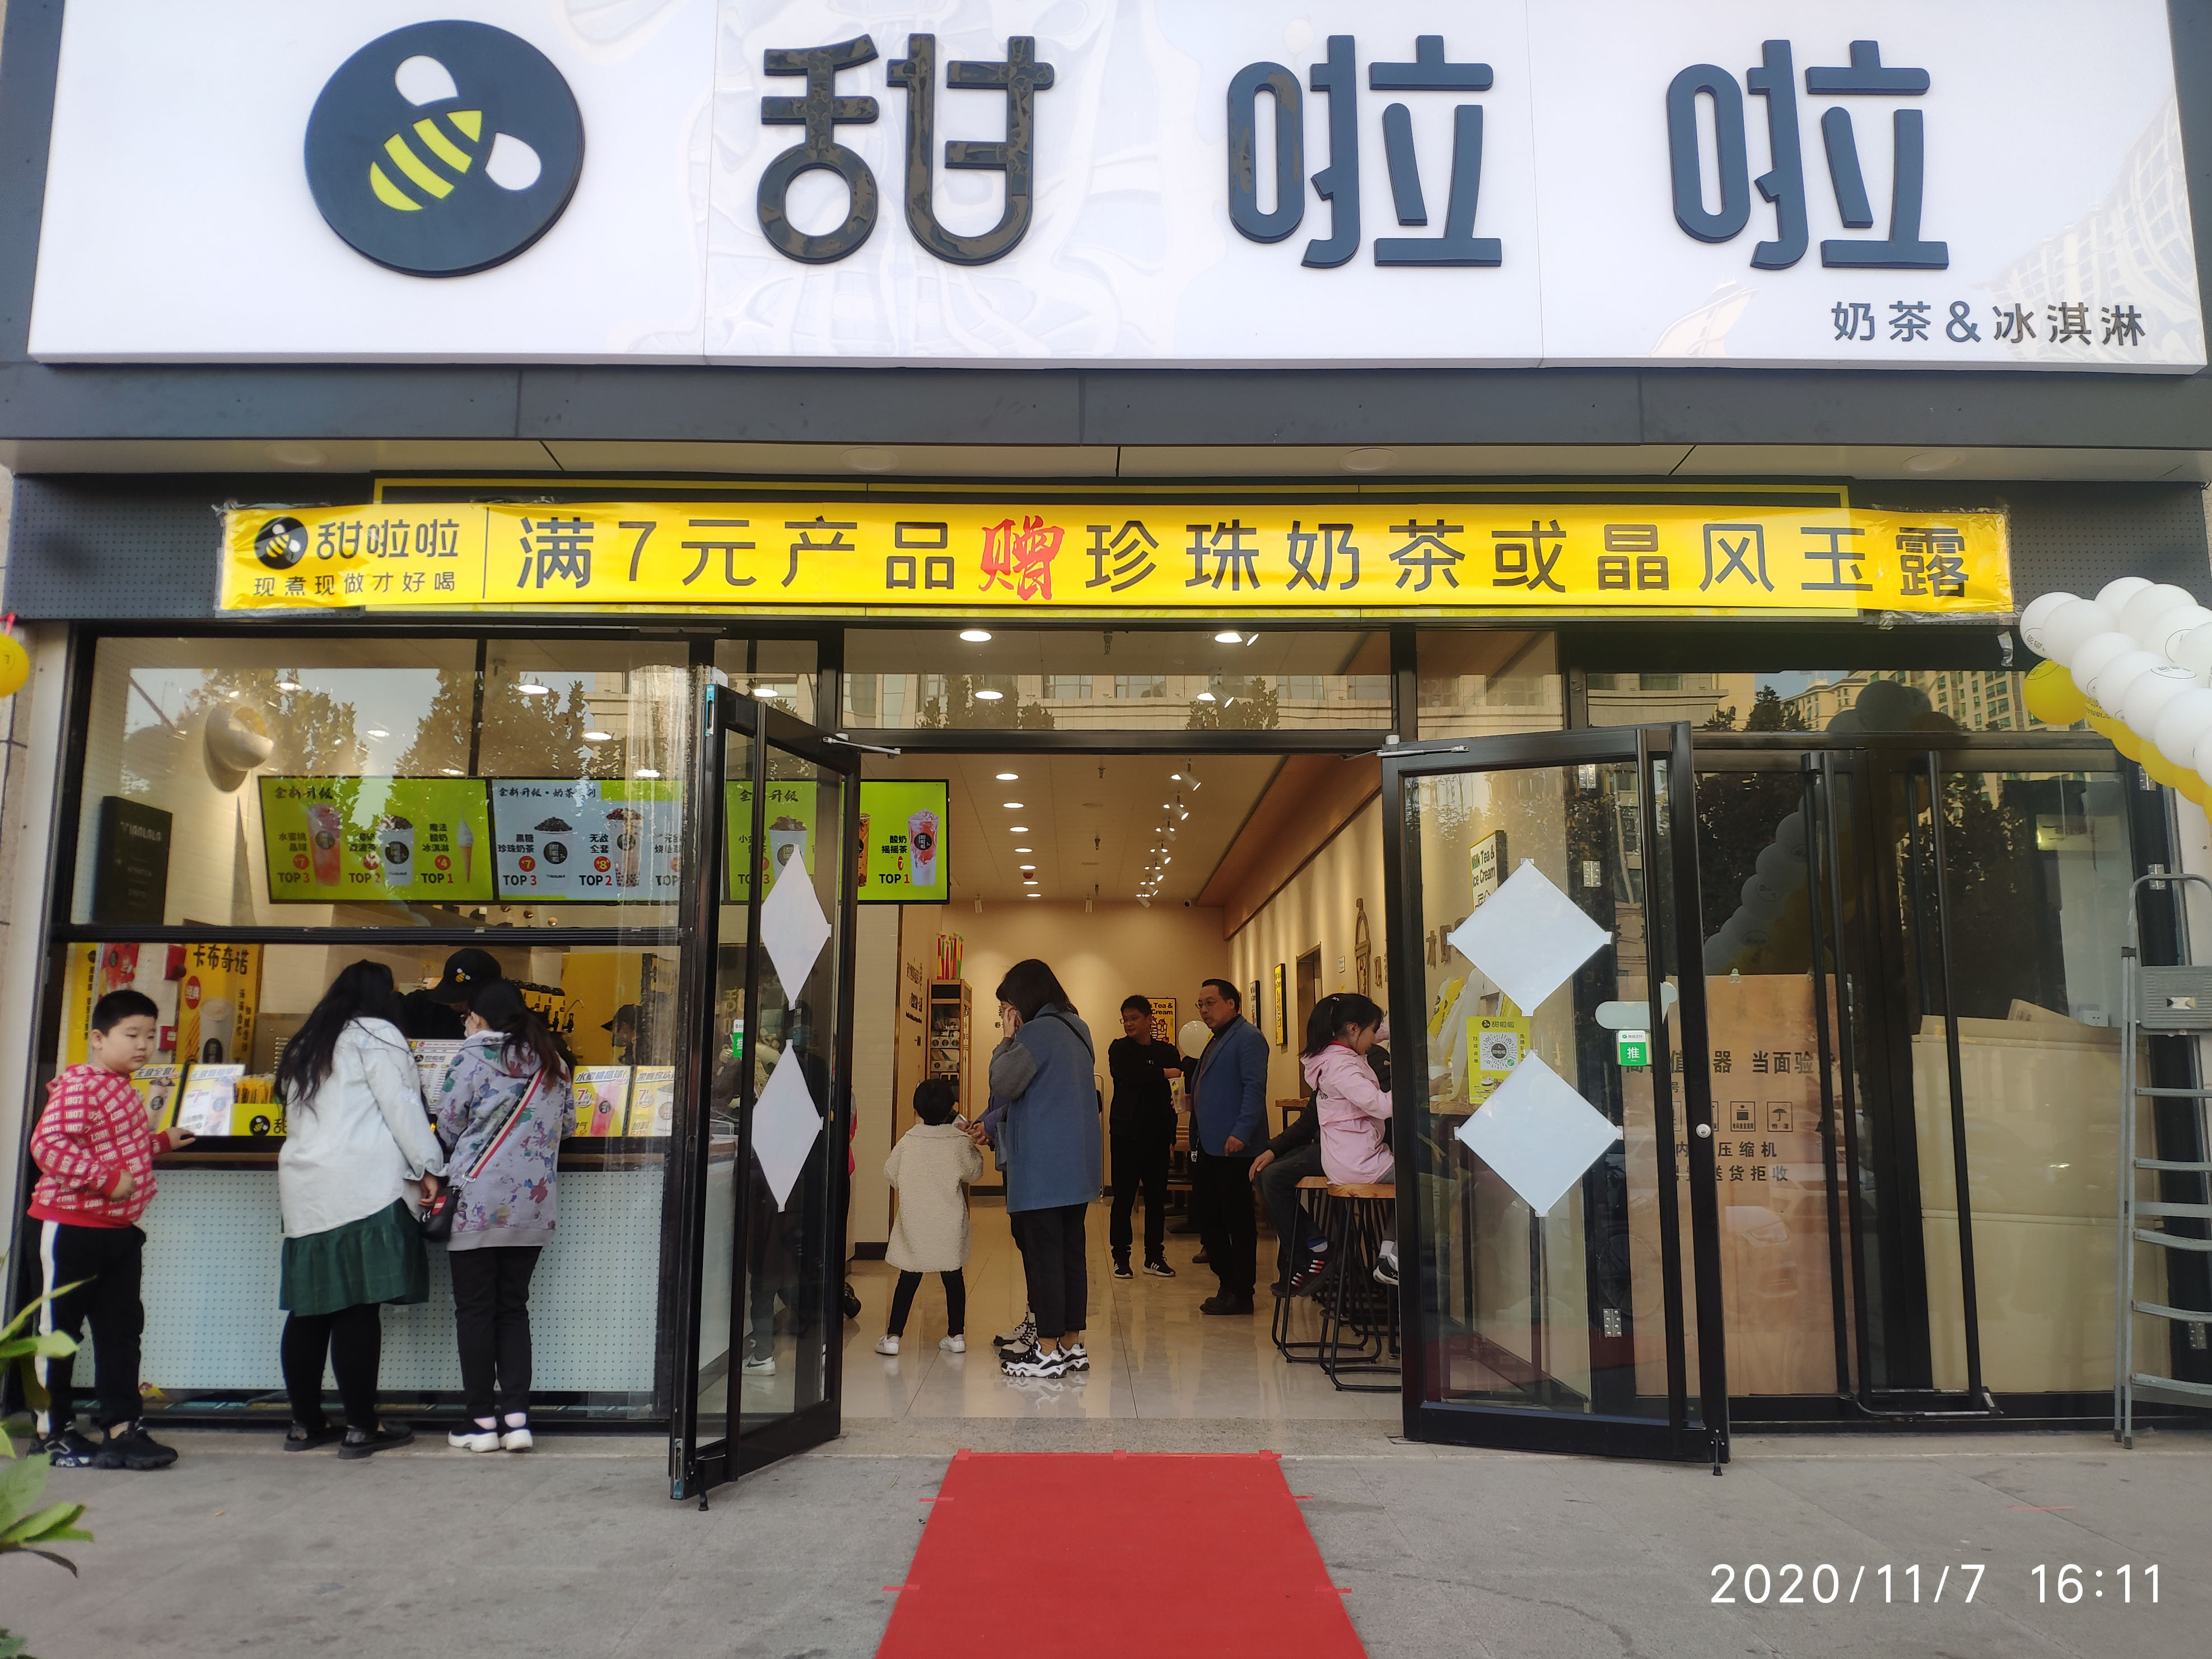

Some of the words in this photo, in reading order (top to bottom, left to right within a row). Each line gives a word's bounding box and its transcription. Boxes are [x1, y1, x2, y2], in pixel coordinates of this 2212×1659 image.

[757, 32, 1949, 269] 甜啦啦
[1831, 301, 2145, 346] 奶茶&冰淇淋
[316, 519, 460, 560] 甜啦啦
[516, 515, 1970, 600] 满7元产品赠珍珠奶茶或晶风玉露
[254, 572, 455, 597] 现煮现做才好喝
[739, 789, 798, 802] 全升级
[890, 835, 907, 844] 酸奶
[498, 844, 534, 854] 珍珠奶茶
[881, 845, 907, 854] 摇摇茶
[1481, 850, 1490, 865] Tea
[1491, 844, 1495, 860] &
[879, 874, 901, 883] TOP
[1480, 866, 1495, 883] Cream
[193, 944, 249, 974] 卡布奇诺
[1627, 1047, 1640, 1059] 推
[64, 1096, 83, 1106] 1807
[65, 1109, 83, 1119] 1807
[65, 1123, 83, 1132] 1807
